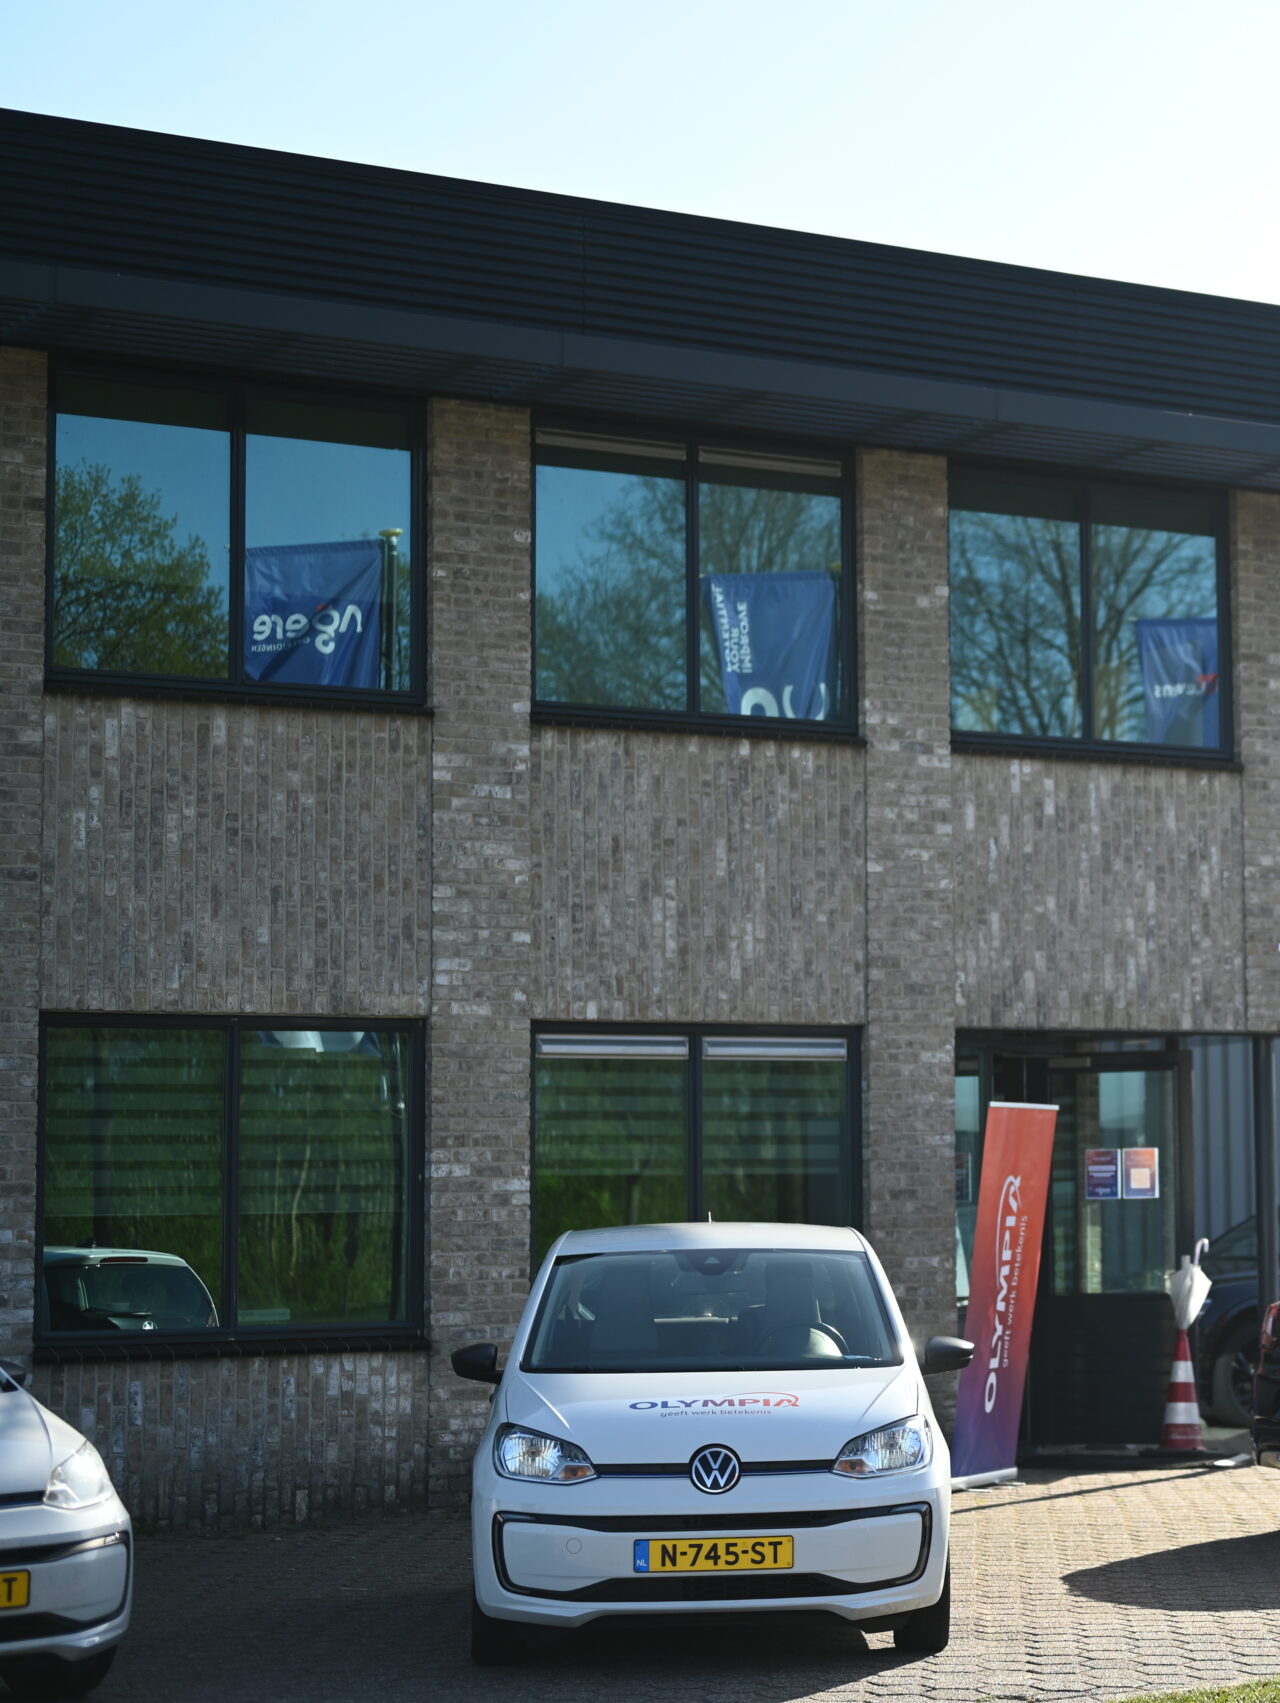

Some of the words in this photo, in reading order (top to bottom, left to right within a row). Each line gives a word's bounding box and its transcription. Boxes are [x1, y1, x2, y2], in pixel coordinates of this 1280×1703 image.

[1012, 1215, 1028, 1286] betekenis
[985, 1175, 1021, 1414] OLYMPIA
[1006, 1288, 1017, 1325] werk
[1002, 1330, 1012, 1368] geeft
[629, 1392, 800, 1410] OLYMPIA
[660, 1410, 688, 1418] geeft
[720, 1408, 771, 1416] betekenis
[636, 1559, 648, 1567] NL
[660, 1541, 783, 1567] N-745-ST
